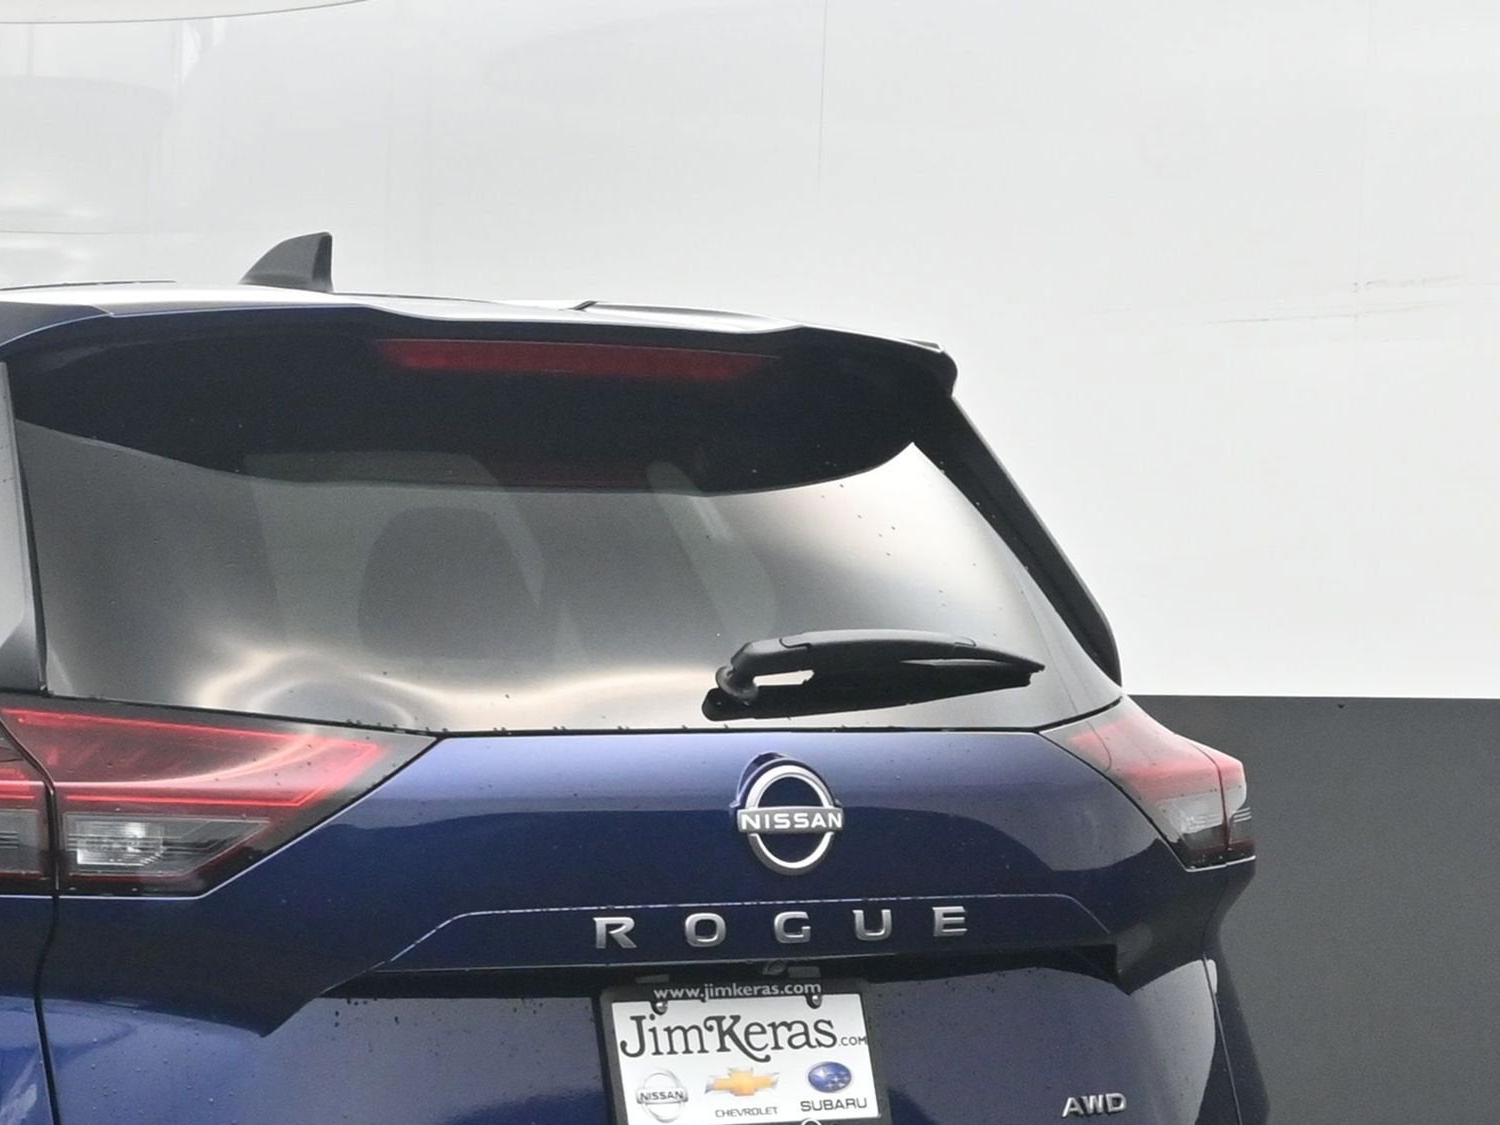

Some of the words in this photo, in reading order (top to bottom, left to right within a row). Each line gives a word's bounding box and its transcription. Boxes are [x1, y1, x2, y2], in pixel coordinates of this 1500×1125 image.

[741, 812, 842, 830] NISSAN
[592, 905, 968, 950] ROGUE
[653, 982, 822, 1000] www.jimkeras.com
[639, 1090, 684, 1101] NISSAN
[715, 1106, 779, 1118] CHEVROLET
[800, 1098, 868, 1112] SUBARU
[1062, 1093, 1126, 1117] AWD
